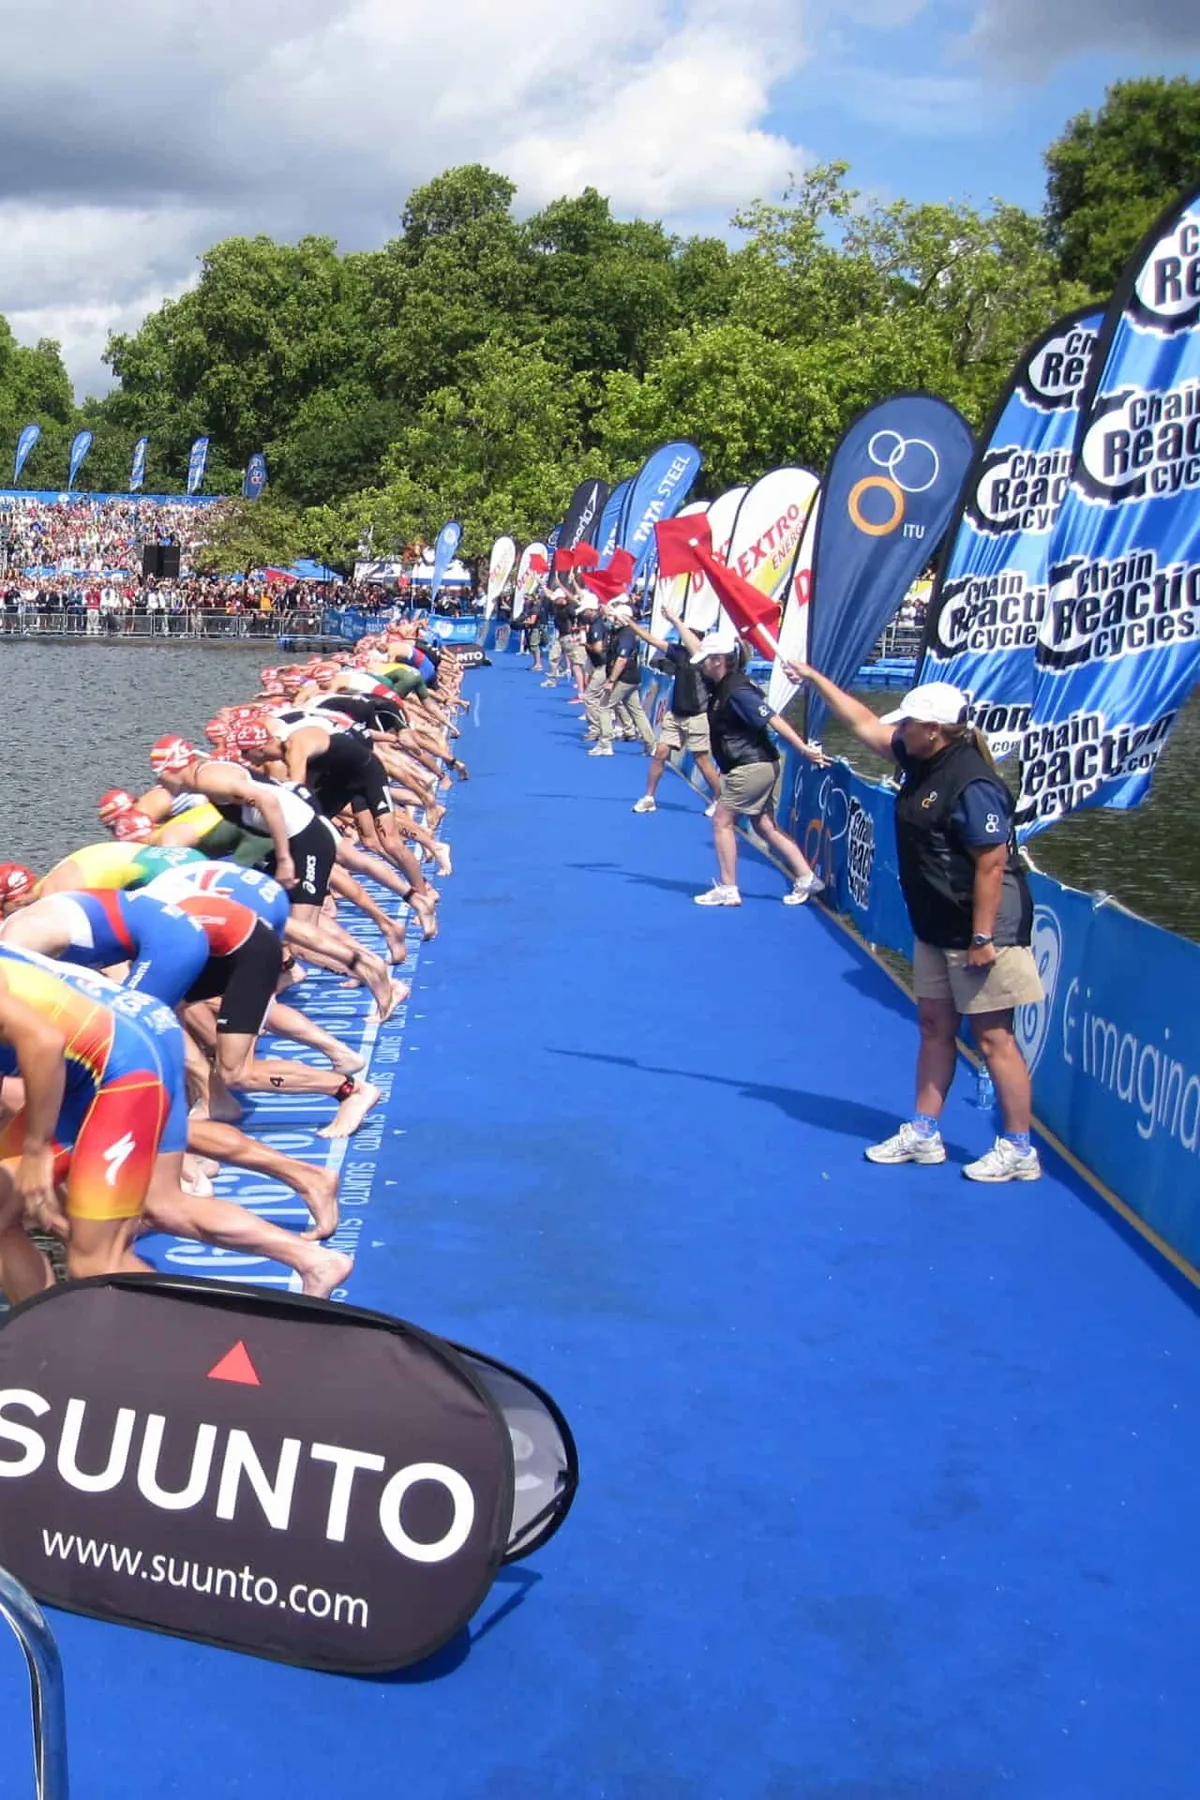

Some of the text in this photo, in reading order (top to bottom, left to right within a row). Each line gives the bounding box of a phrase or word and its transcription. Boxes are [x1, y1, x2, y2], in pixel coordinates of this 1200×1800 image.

[1129, 385, 1200, 431] Chai
[1103, 417, 1200, 478] Reac
[633, 456, 691, 542] TATA STEEL
[990, 476, 1068, 515] Reac
[733, 503, 800, 579] EXTRO
[903, 524, 925, 539] ITU
[1076, 553, 1153, 599] Chain
[949, 588, 1046, 643] Reacti
[1052, 565, 1200, 646] Reactio
[971, 624, 1037, 651] cycle
[1024, 714, 1099, 761] Chain
[374, 1036, 402, 1064] SUUNTO
[1083, 987, 1200, 1154] imagina
[270, 1076, 285, 1088] 4
[339, 1161, 377, 1206] SUUNTO
[42, 1527, 369, 1628] www.suunto.com
